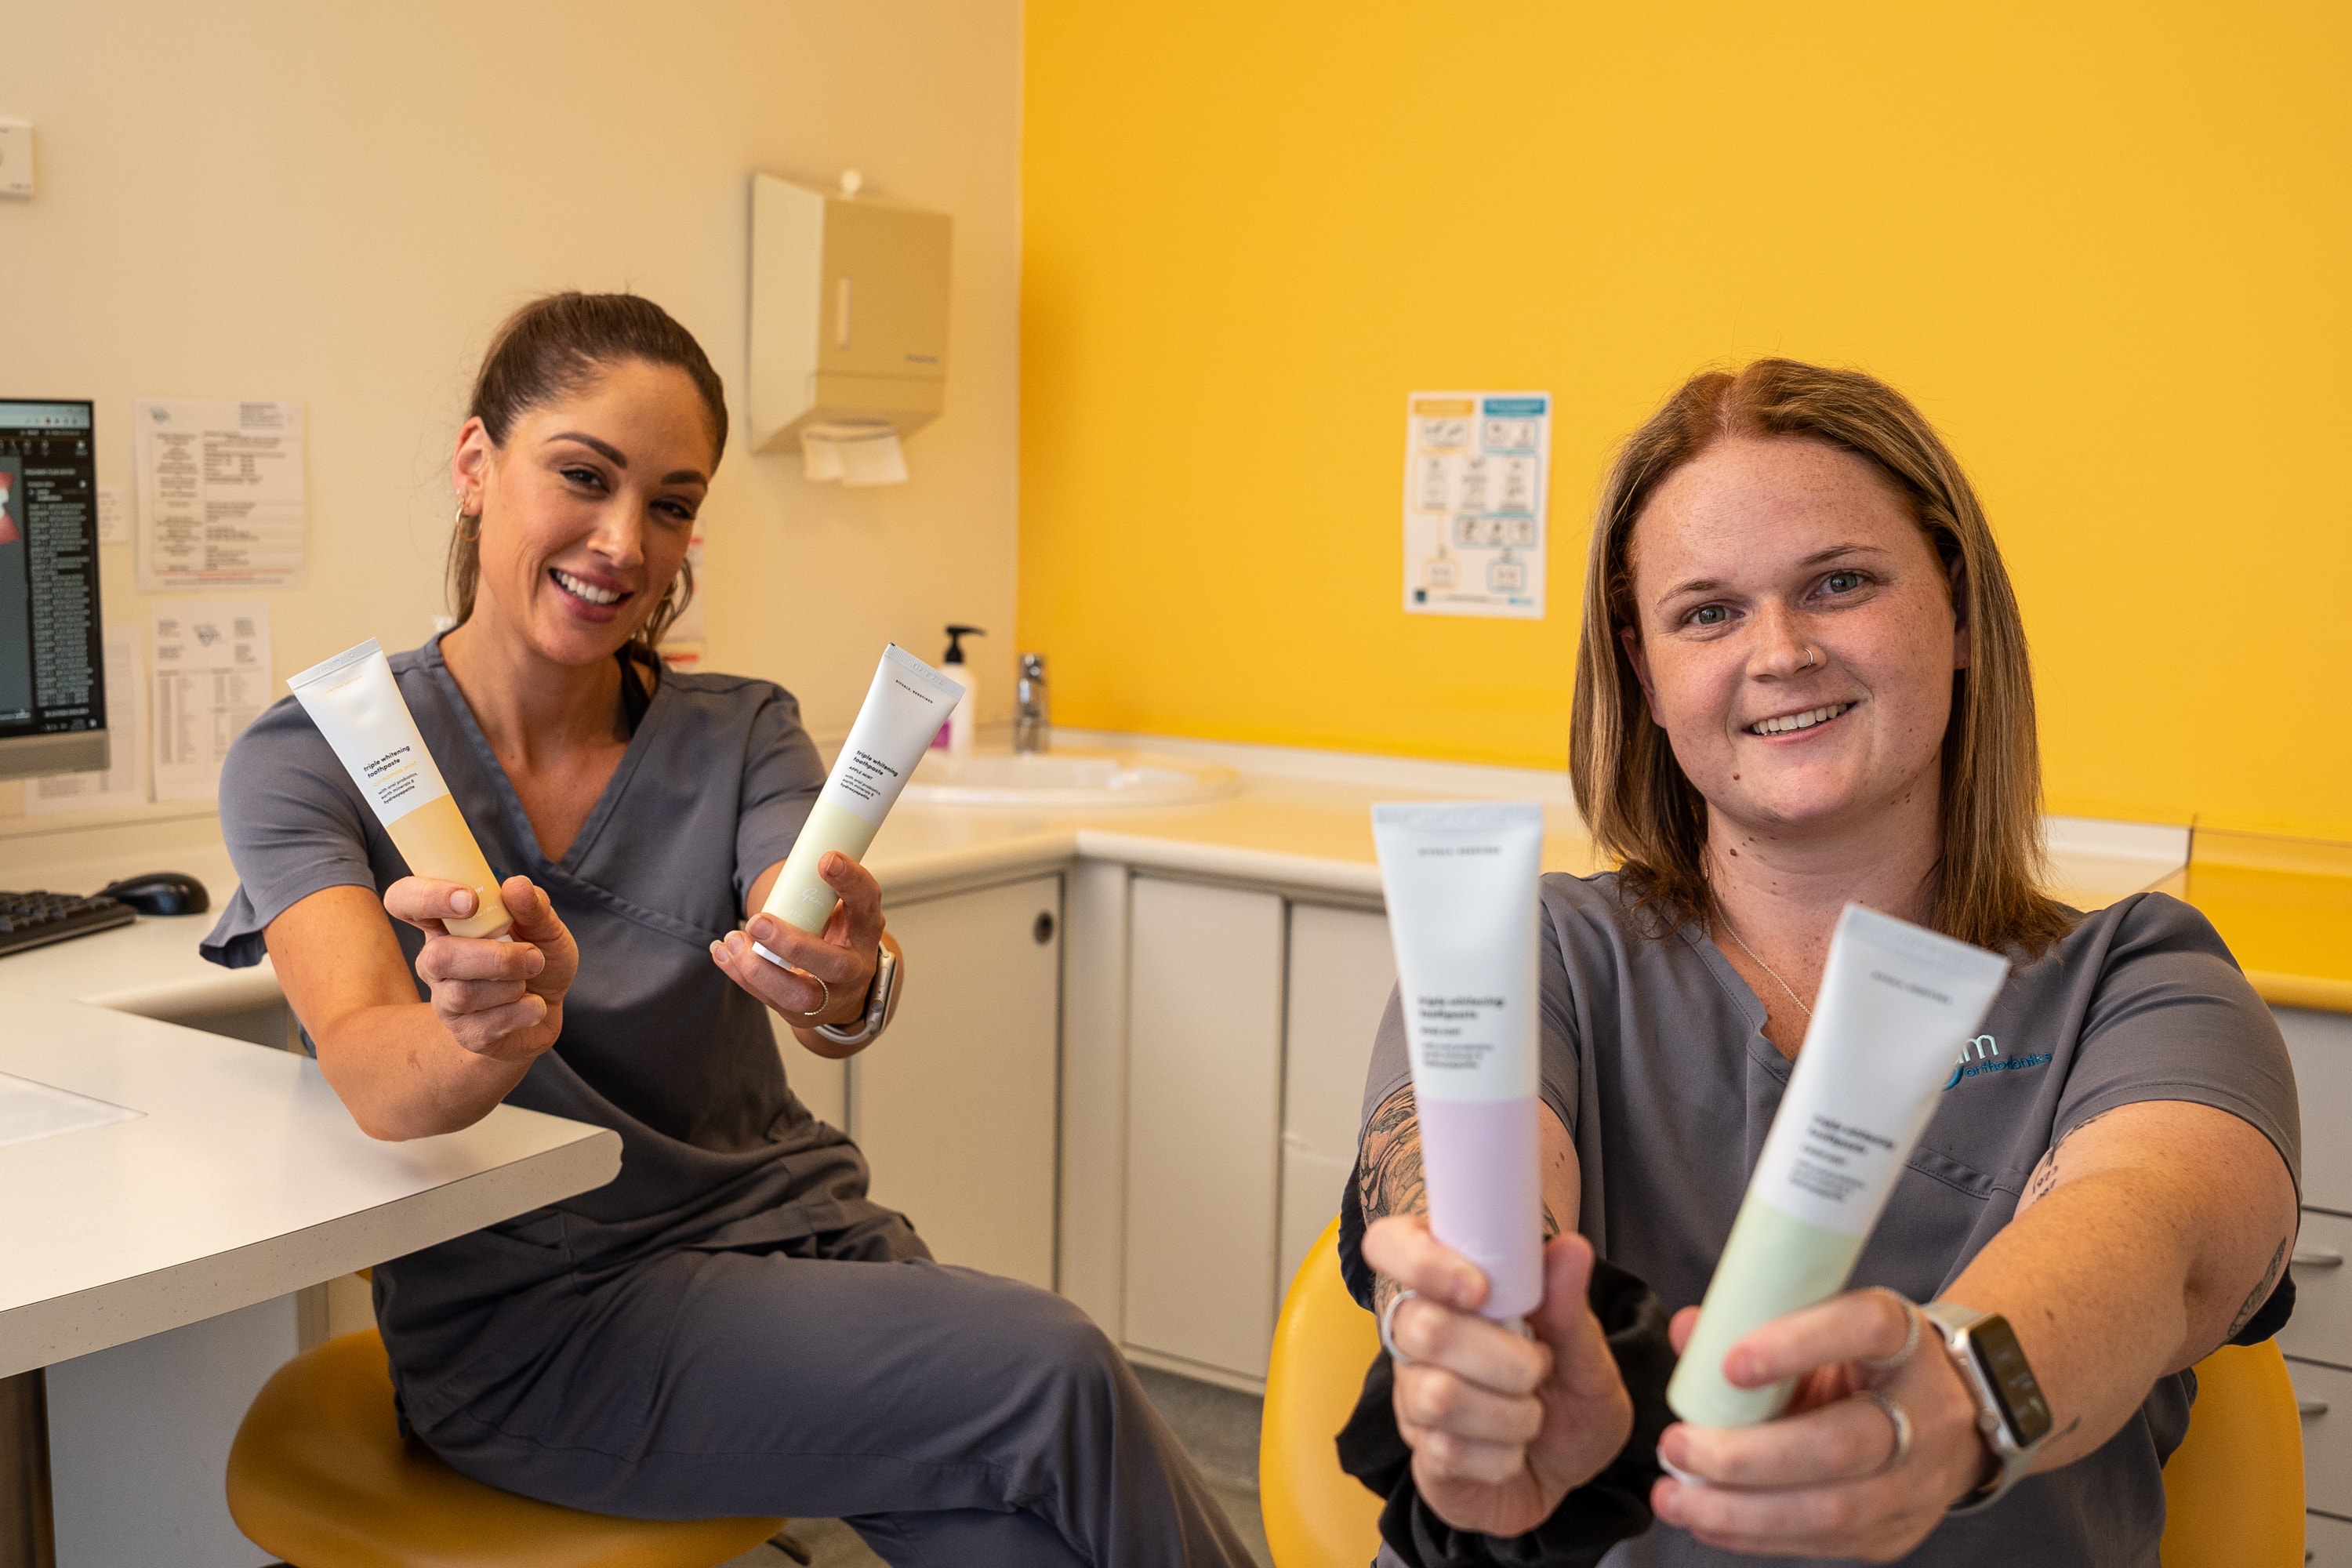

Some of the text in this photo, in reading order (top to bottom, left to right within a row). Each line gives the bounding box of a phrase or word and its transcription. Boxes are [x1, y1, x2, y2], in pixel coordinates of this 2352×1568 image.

[363, 746, 411, 772] triple whitening
[368, 758, 401, 779] toothpaste
[853, 757, 884, 775] toothpaste
[856, 750, 898, 777] triple whitening
[373, 760, 417, 787] cinnamon mint
[848, 766, 873, 780] APPLE MINT
[381, 791, 392, 800] earth
[393, 781, 411, 793] minerals
[854, 784, 870, 795] minerals
[1965, 1052, 2053, 1077] orthodontics
